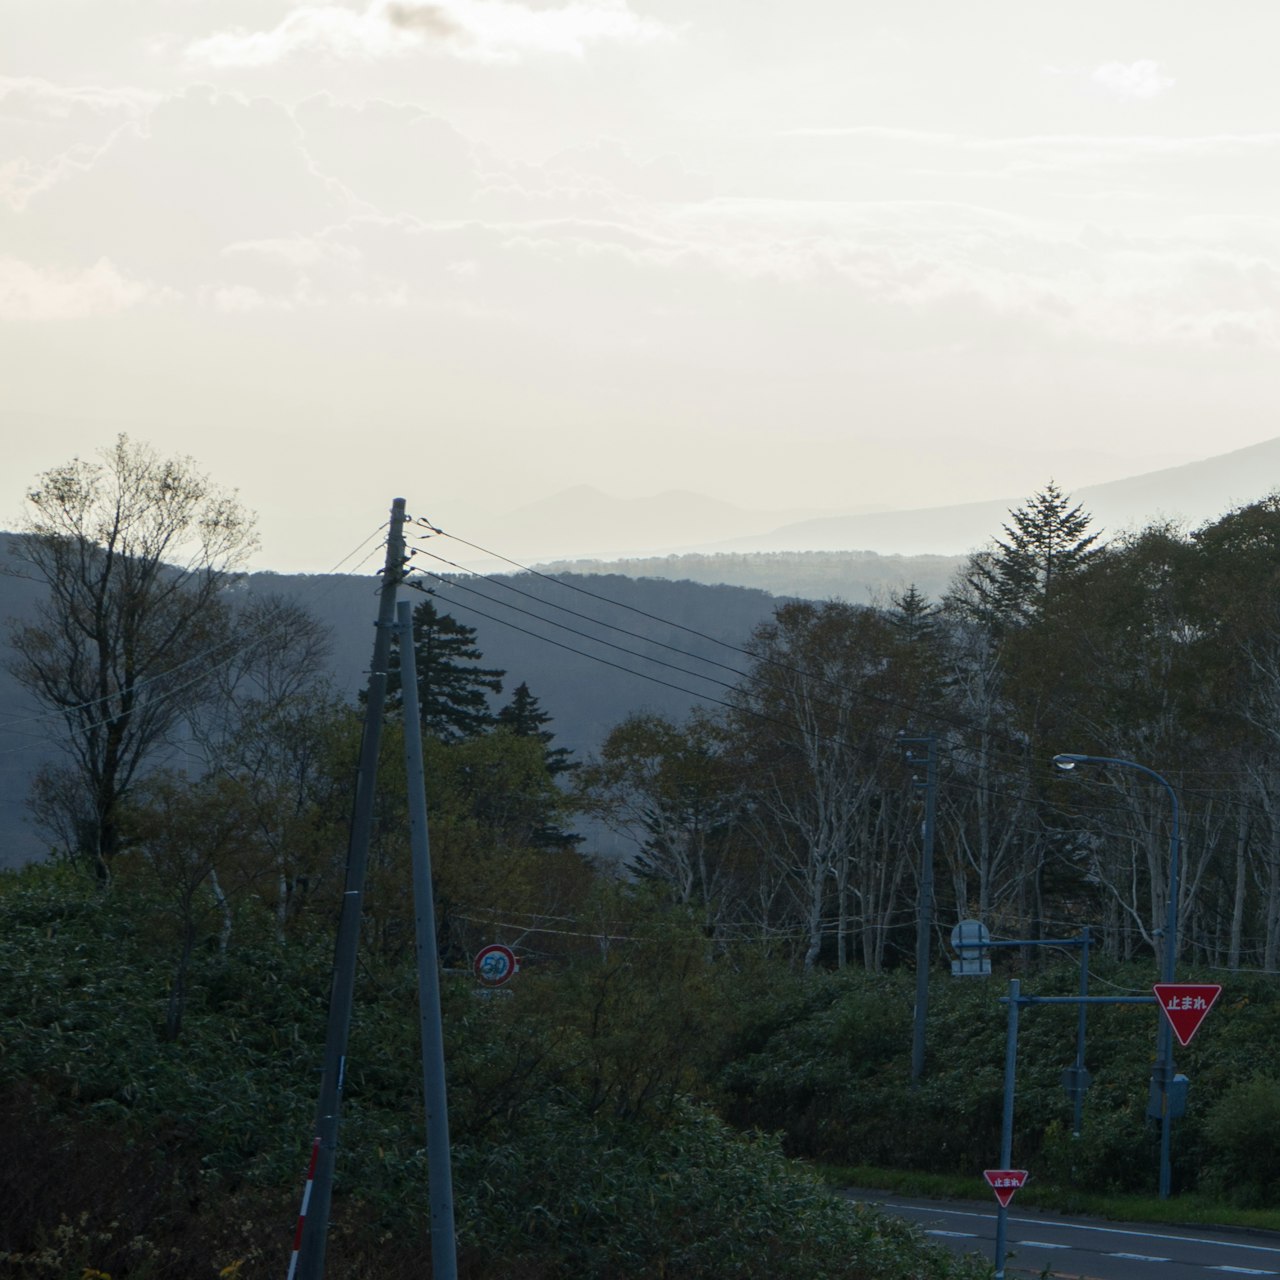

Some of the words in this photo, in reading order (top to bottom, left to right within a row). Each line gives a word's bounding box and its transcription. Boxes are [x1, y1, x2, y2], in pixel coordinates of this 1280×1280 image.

[1167, 996, 1207, 1011] 止まれ
[994, 1178, 1020, 1188] 止まれ
